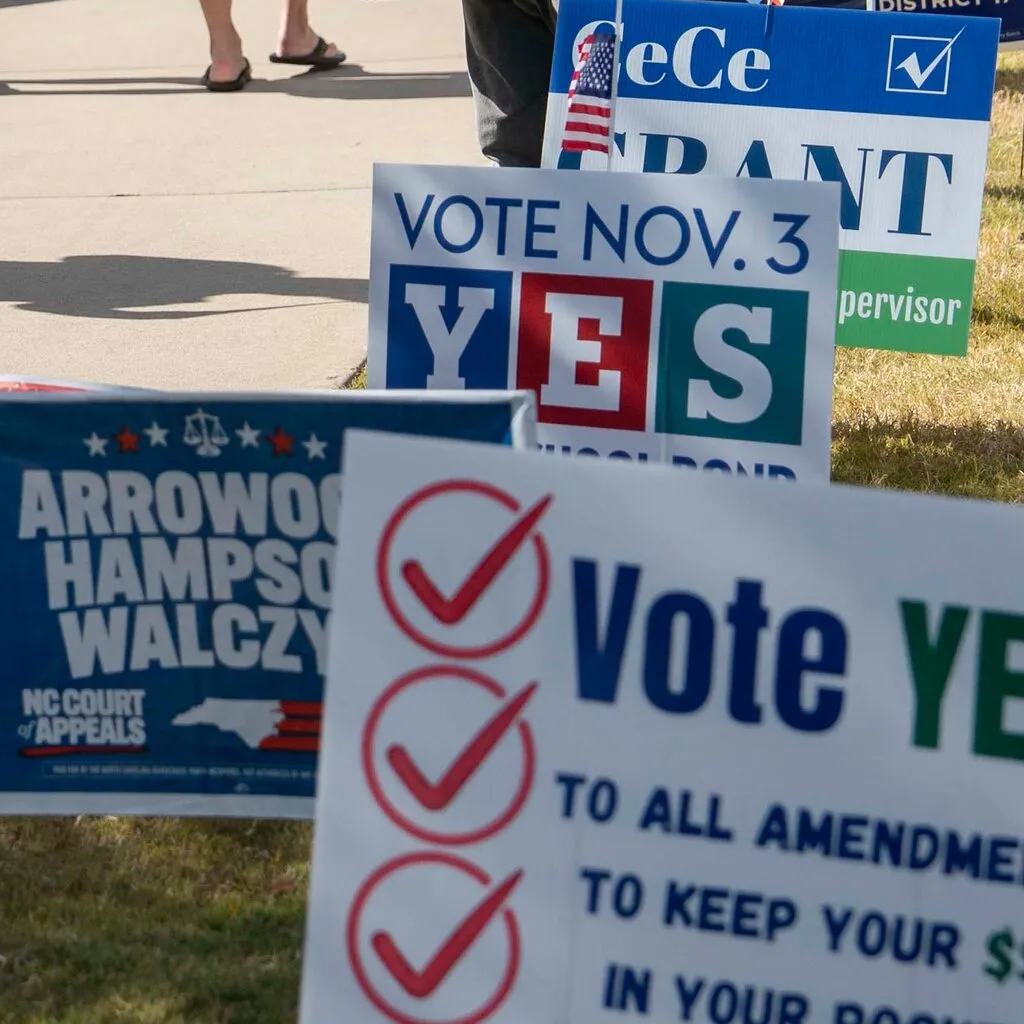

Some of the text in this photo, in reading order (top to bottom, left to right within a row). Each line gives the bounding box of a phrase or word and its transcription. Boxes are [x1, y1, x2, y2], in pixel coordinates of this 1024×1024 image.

[394, 192, 811, 275] VOTE NOV. 3
[838, 286, 962, 325] pervisor
[404, 282, 774, 424] YES
[571, 557, 849, 734] Vote
[18, 717, 147, 745] of APPEALS
[22, 688, 145, 716] NC COURT
[555, 772, 618, 825] TO
[638, 785, 734, 842] ALL
[579, 867, 644, 919] TO
[662, 880, 798, 941] KEEP
[821, 904, 961, 968] YOUR
[601, 962, 652, 1015] IN
